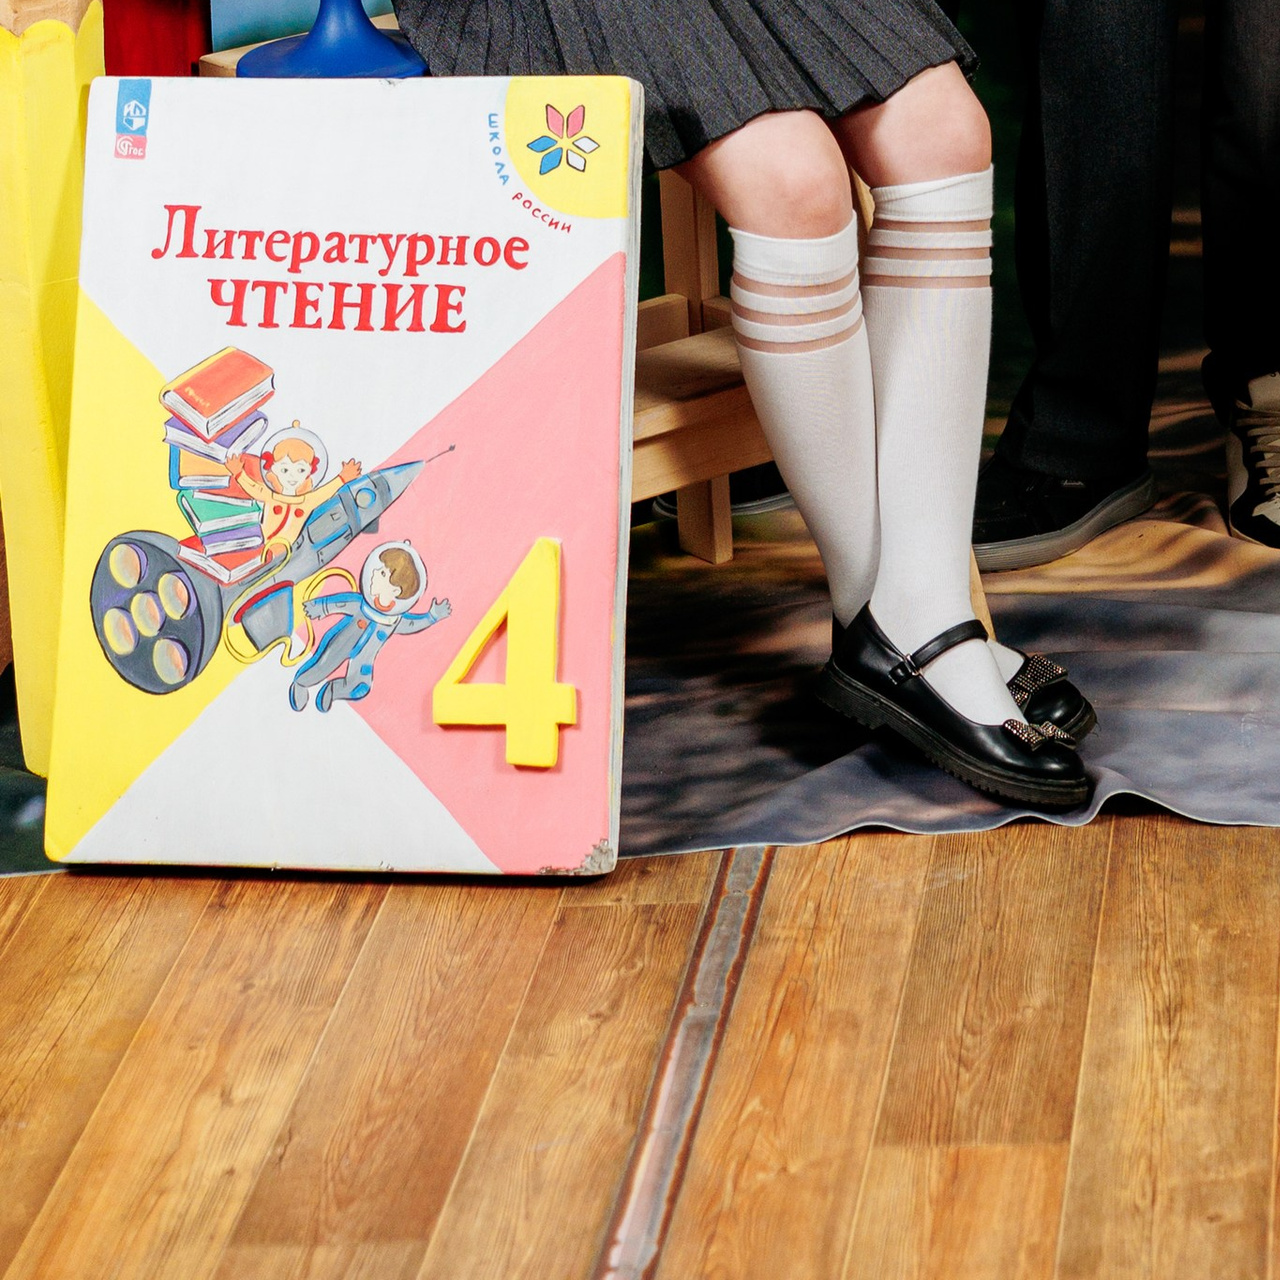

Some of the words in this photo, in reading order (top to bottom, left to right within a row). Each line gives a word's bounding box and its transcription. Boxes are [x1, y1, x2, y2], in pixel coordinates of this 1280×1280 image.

[152, 204, 530, 275] Литературное
[207, 278, 467, 334] ЧТЕНИЕ
[433, 537, 579, 769] 4
